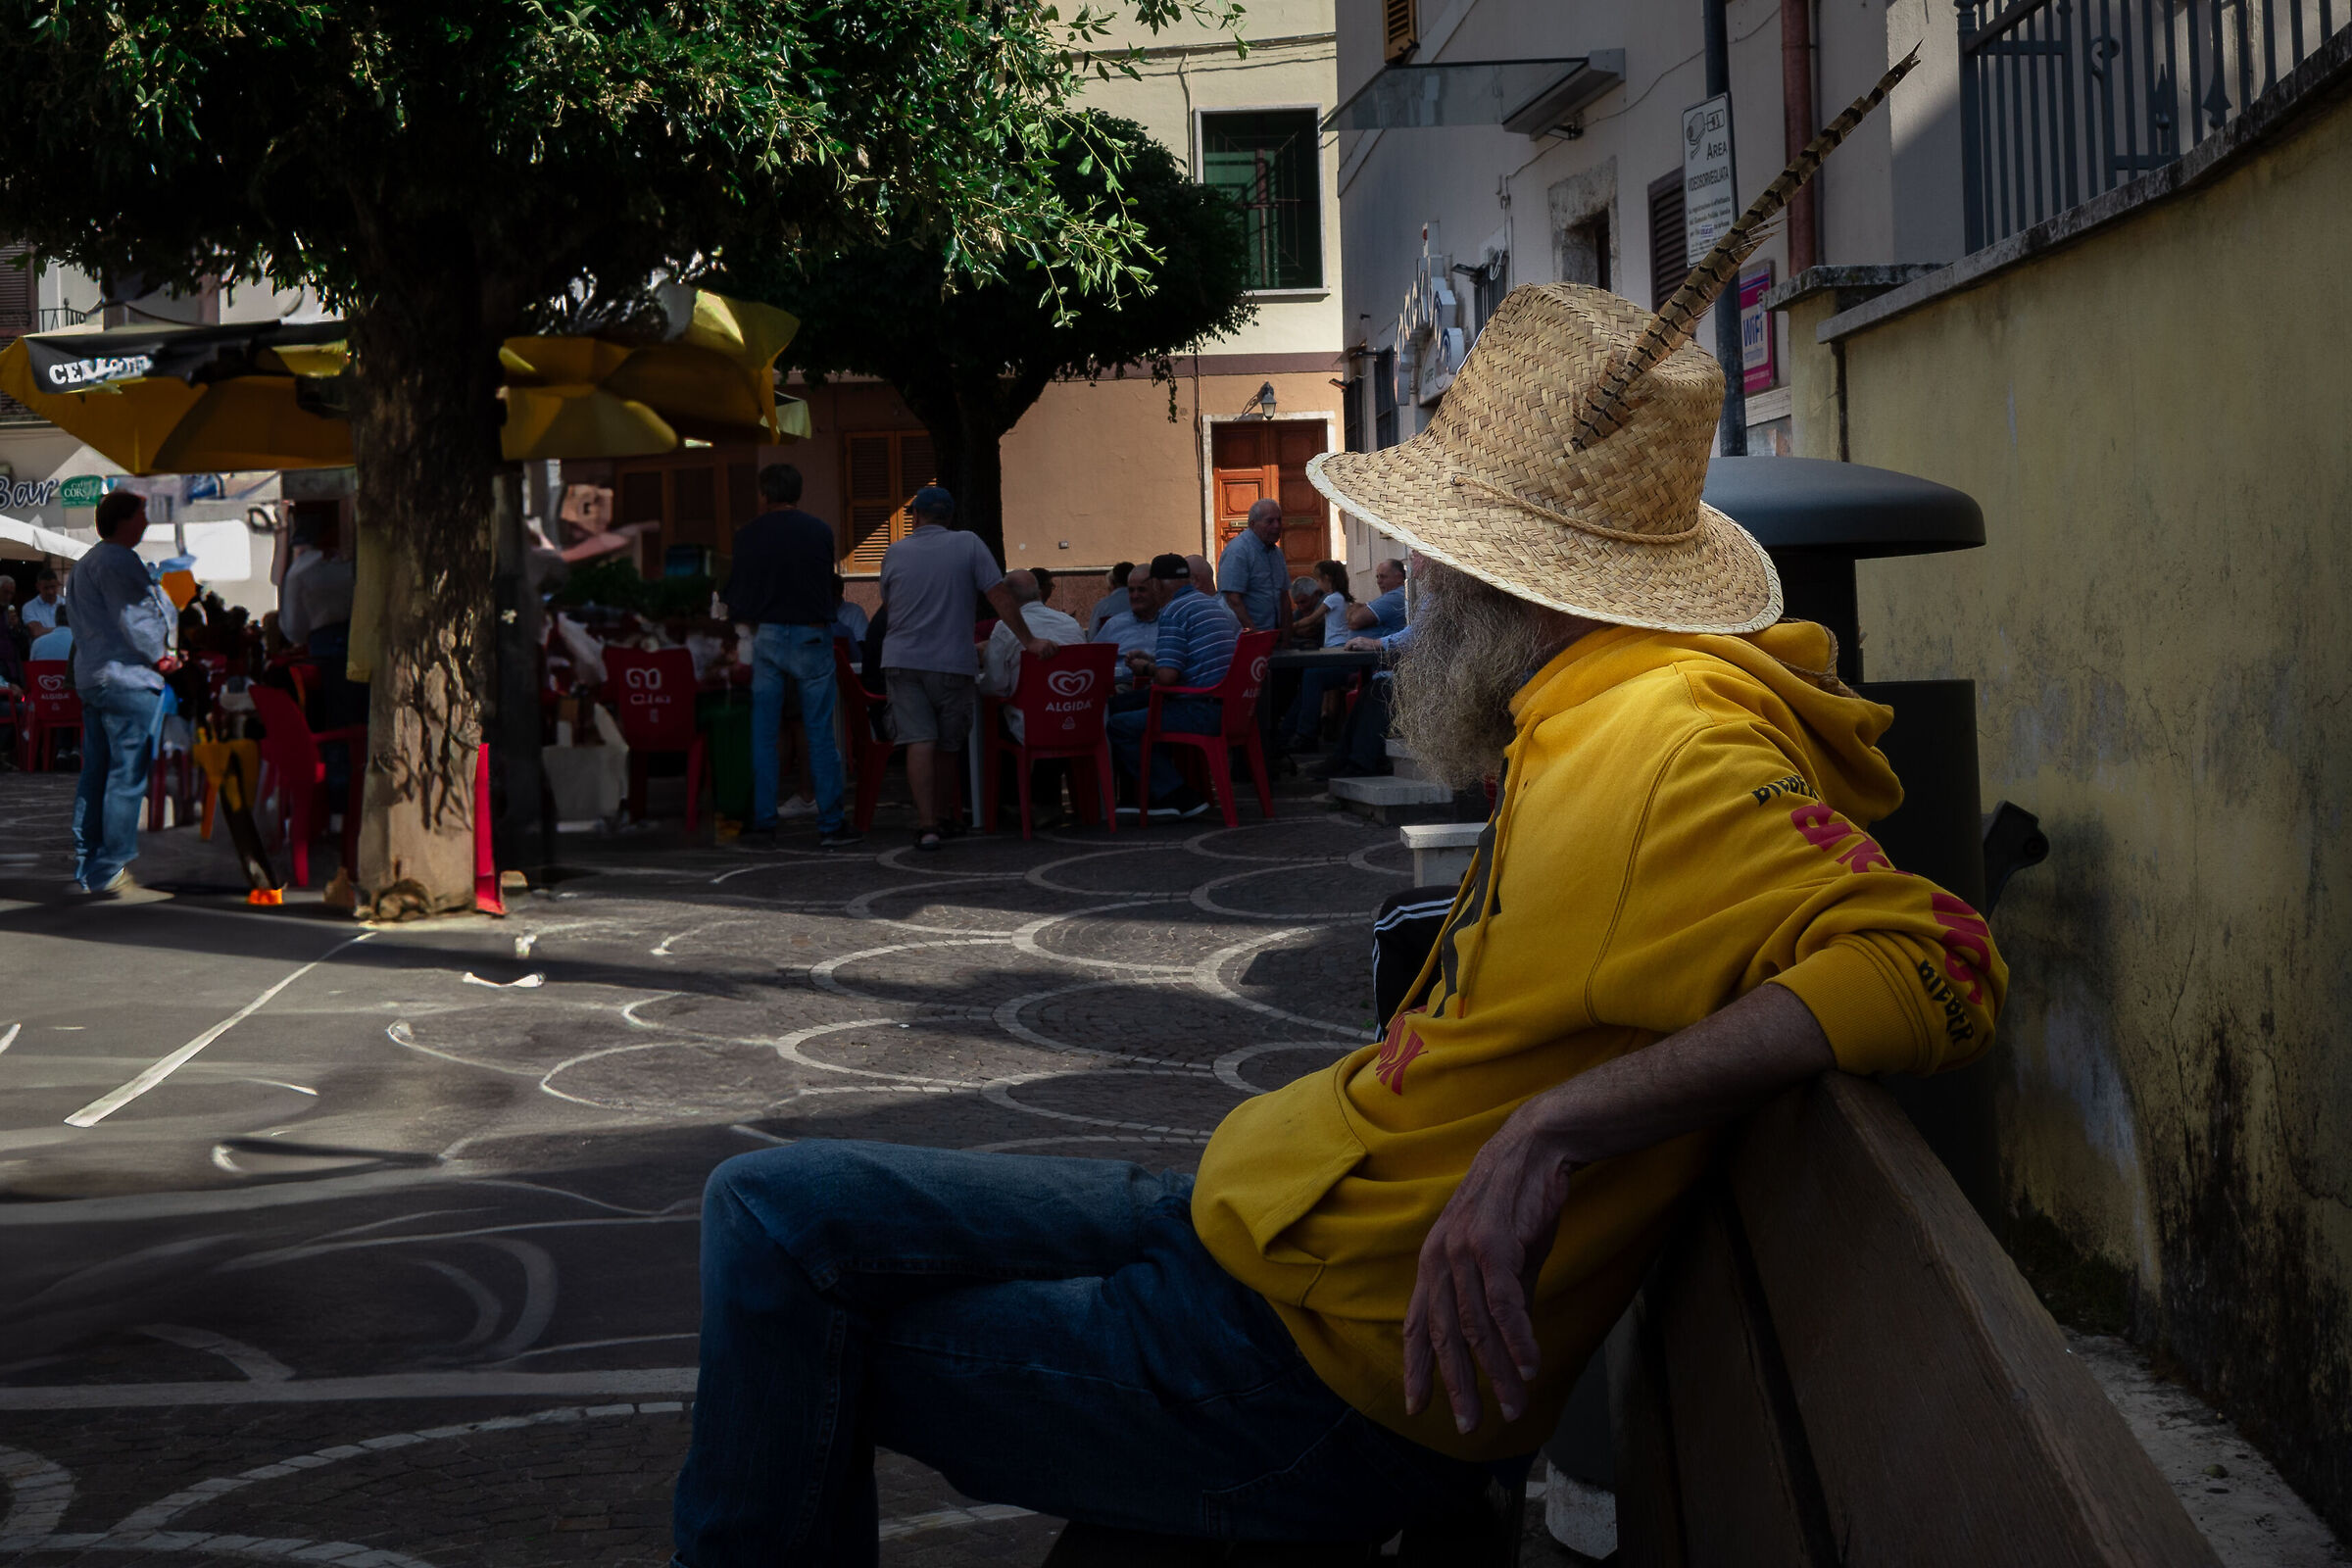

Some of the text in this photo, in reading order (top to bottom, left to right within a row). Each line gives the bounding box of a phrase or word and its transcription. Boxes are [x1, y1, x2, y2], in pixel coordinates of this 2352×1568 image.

[1706, 141, 1728, 161] AREA
[1045, 700, 1092, 711] ALGIDA
[1918, 958, 1975, 1046] BIEBER
